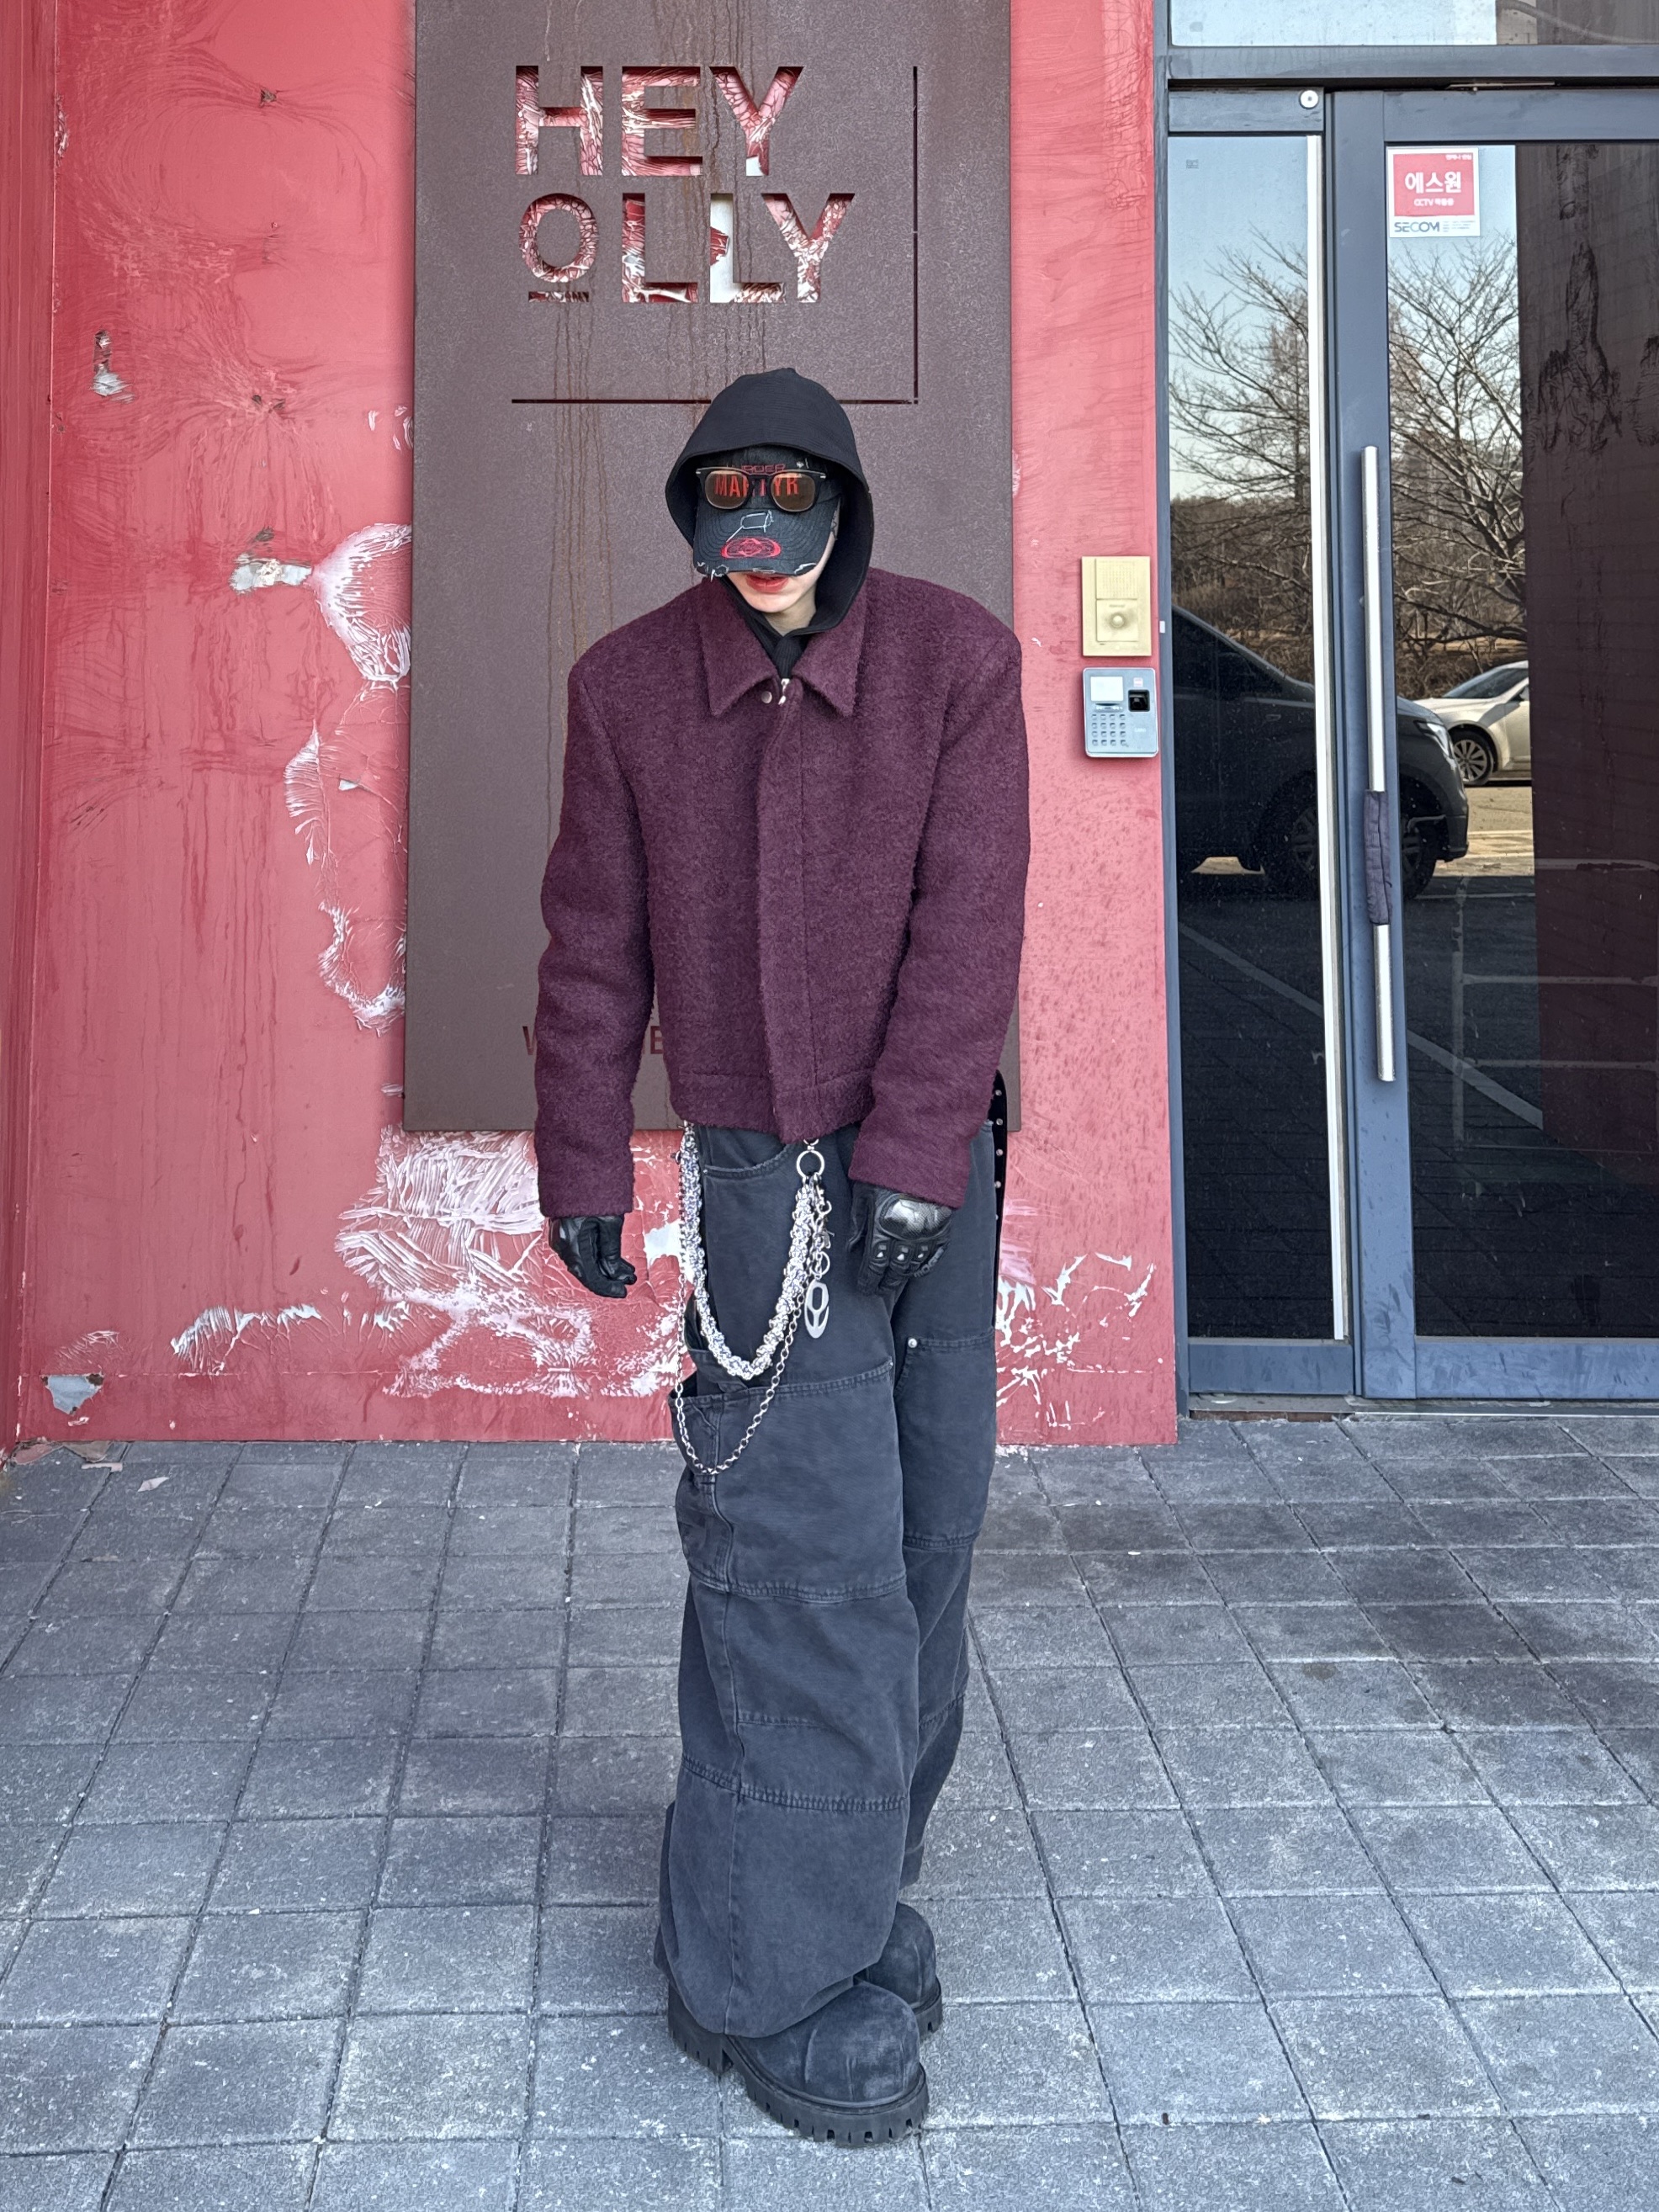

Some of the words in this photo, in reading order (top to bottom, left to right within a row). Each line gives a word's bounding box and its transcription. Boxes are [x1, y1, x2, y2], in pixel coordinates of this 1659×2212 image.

[516, 66, 804, 177] HEY
[1405, 172, 1461, 194] 에스원
[519, 193, 856, 303] OLLY
[1394, 221, 1439, 232] SECOM
